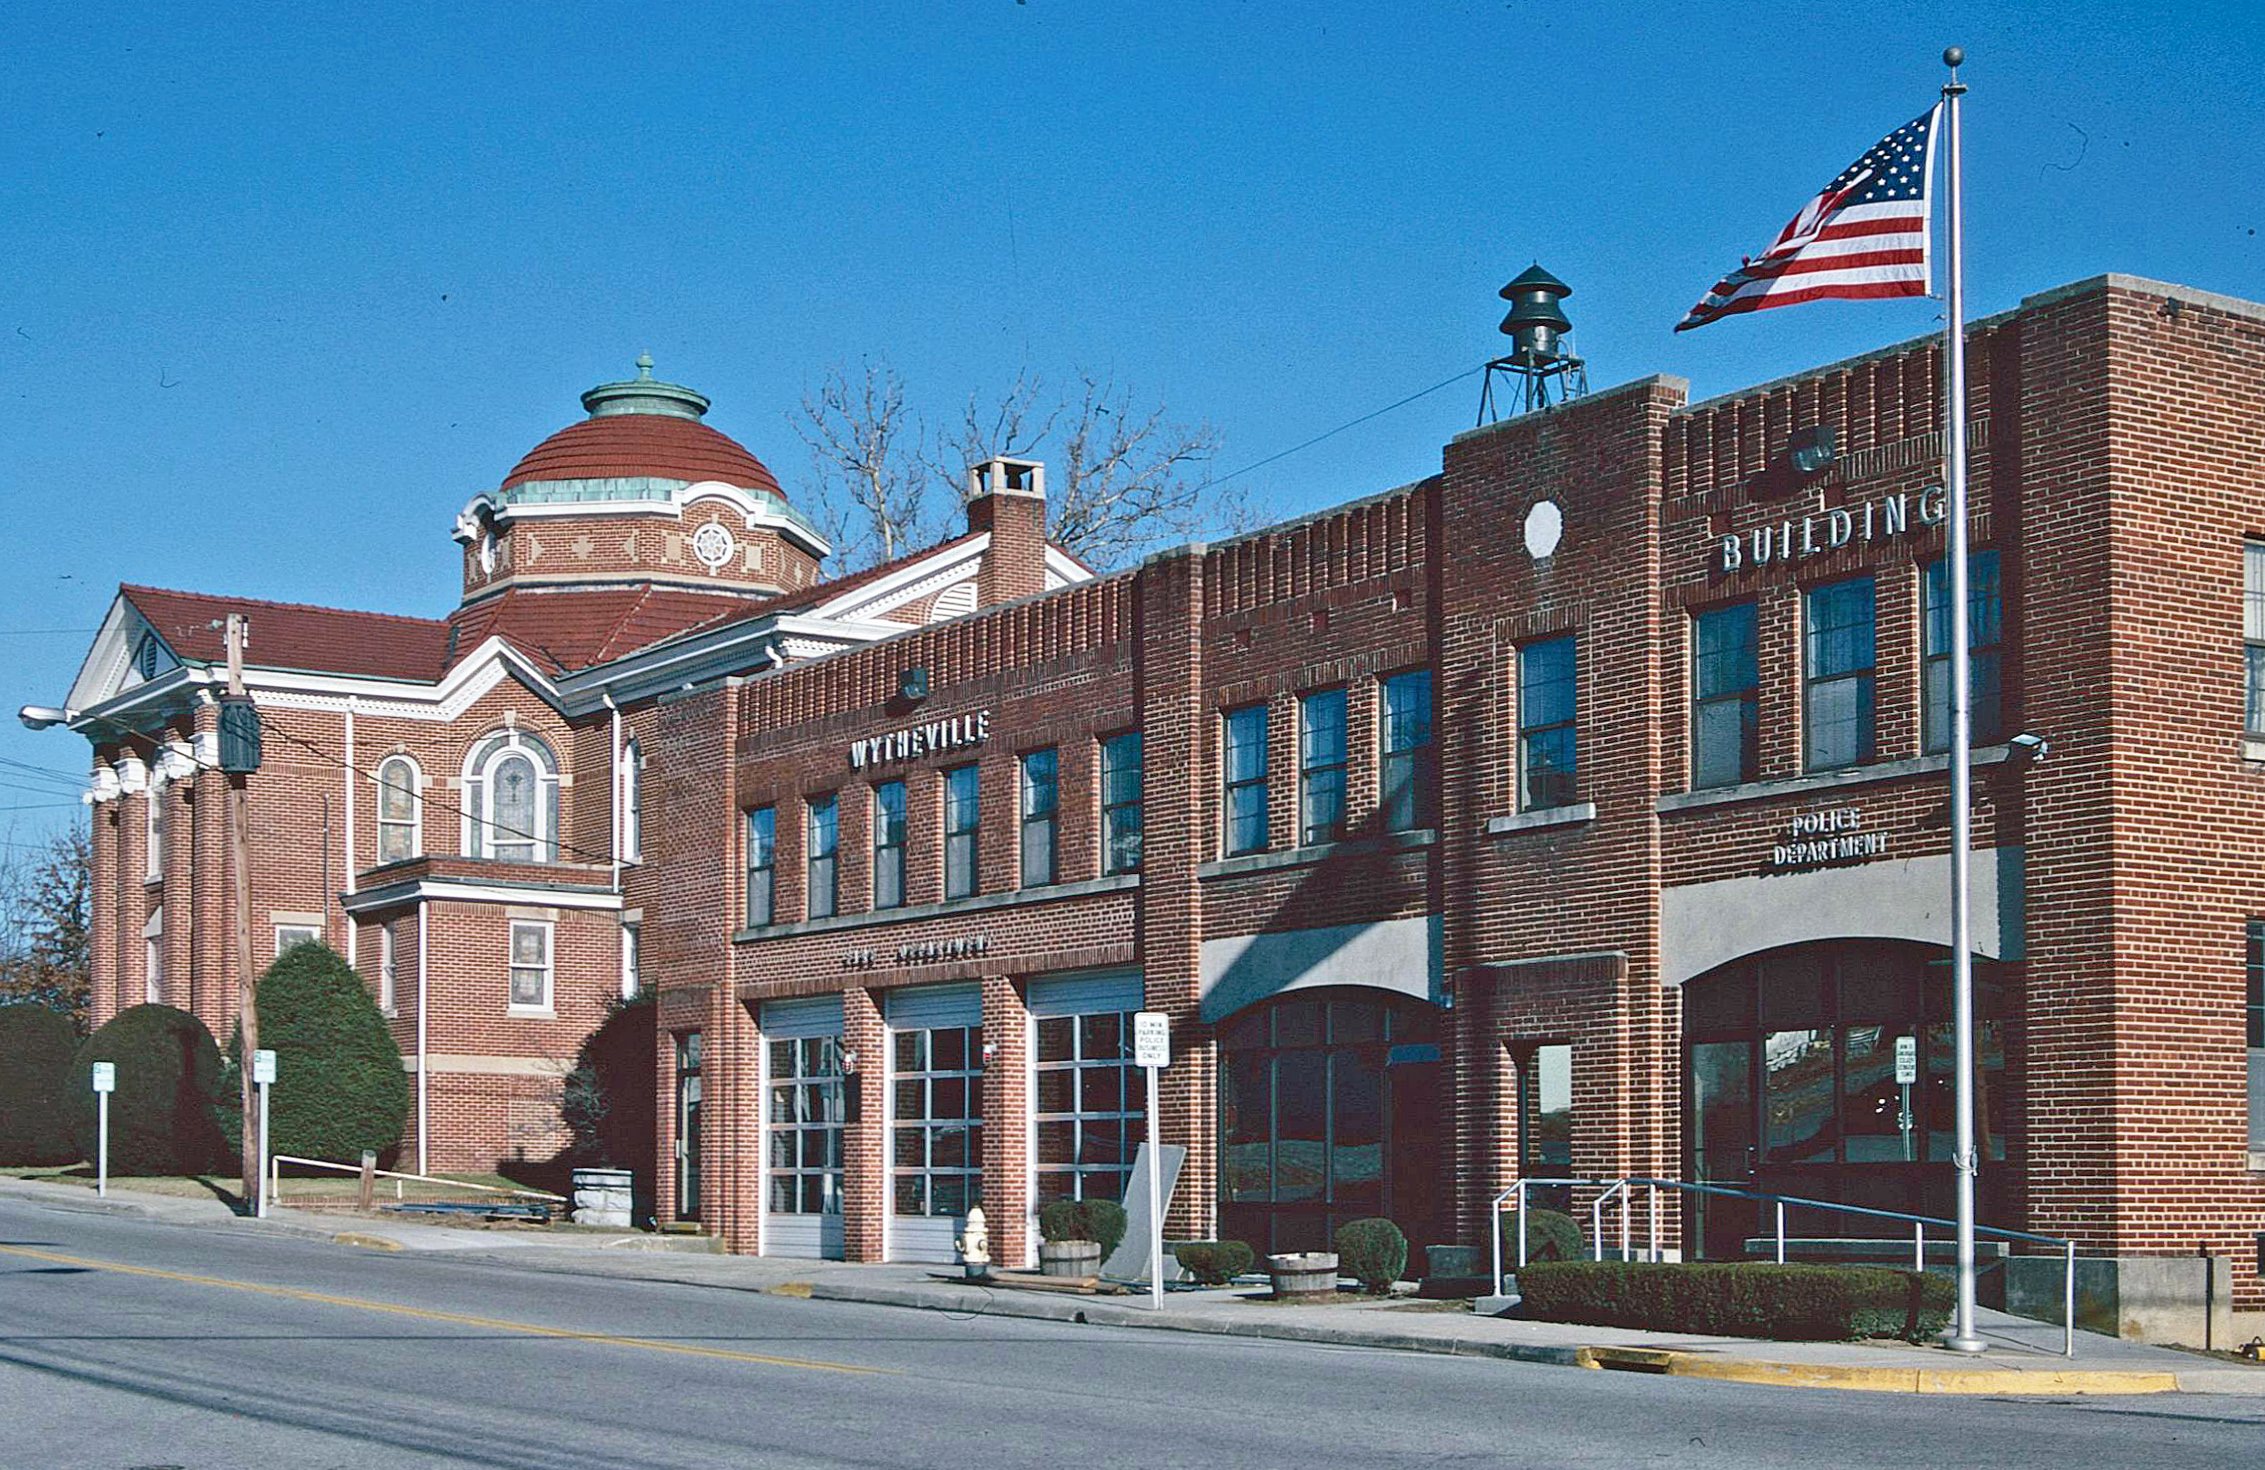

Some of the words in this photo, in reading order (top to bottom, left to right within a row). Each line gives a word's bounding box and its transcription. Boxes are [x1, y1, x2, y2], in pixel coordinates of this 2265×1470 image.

[1723, 487, 1945, 571] BUILDING
[851, 710, 990, 767] WYTHEVILLE
[1793, 808, 1860, 837] POLICE
[1774, 831, 1888, 865] DEPARTMENT
